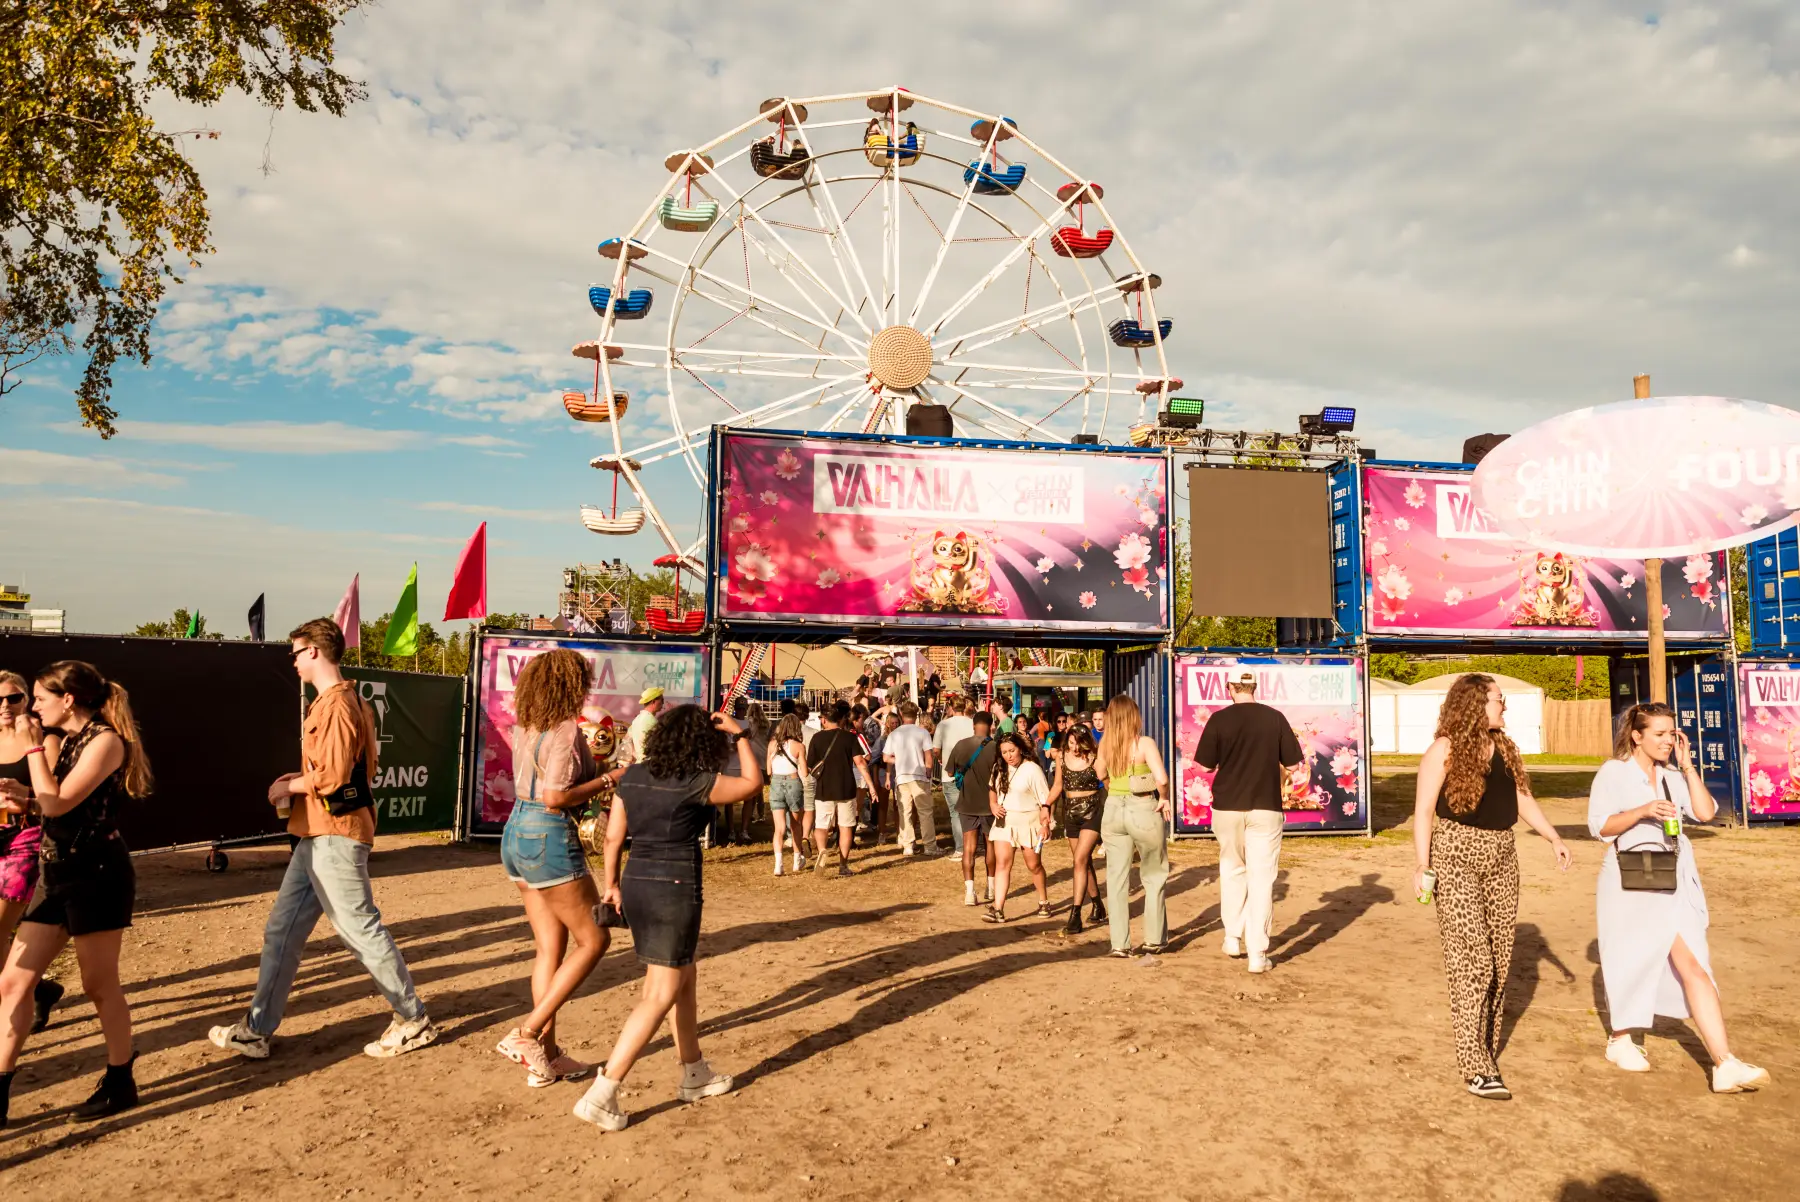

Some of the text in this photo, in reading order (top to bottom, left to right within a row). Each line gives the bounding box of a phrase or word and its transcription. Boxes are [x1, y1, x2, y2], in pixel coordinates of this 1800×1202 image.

[1517, 449, 1609, 485] CHIN
[827, 461, 979, 513] VALHALLA
[1015, 473, 1072, 491] CHIN
[1014, 498, 1071, 516] CHIN
[1516, 485, 1608, 518] CHIN
[644, 661, 687, 675] CHIN
[642, 679, 685, 691] CHIN
[1309, 671, 1344, 686] CHIN
[1309, 688, 1344, 701] CHIN
[388, 796, 427, 818] EXIT
